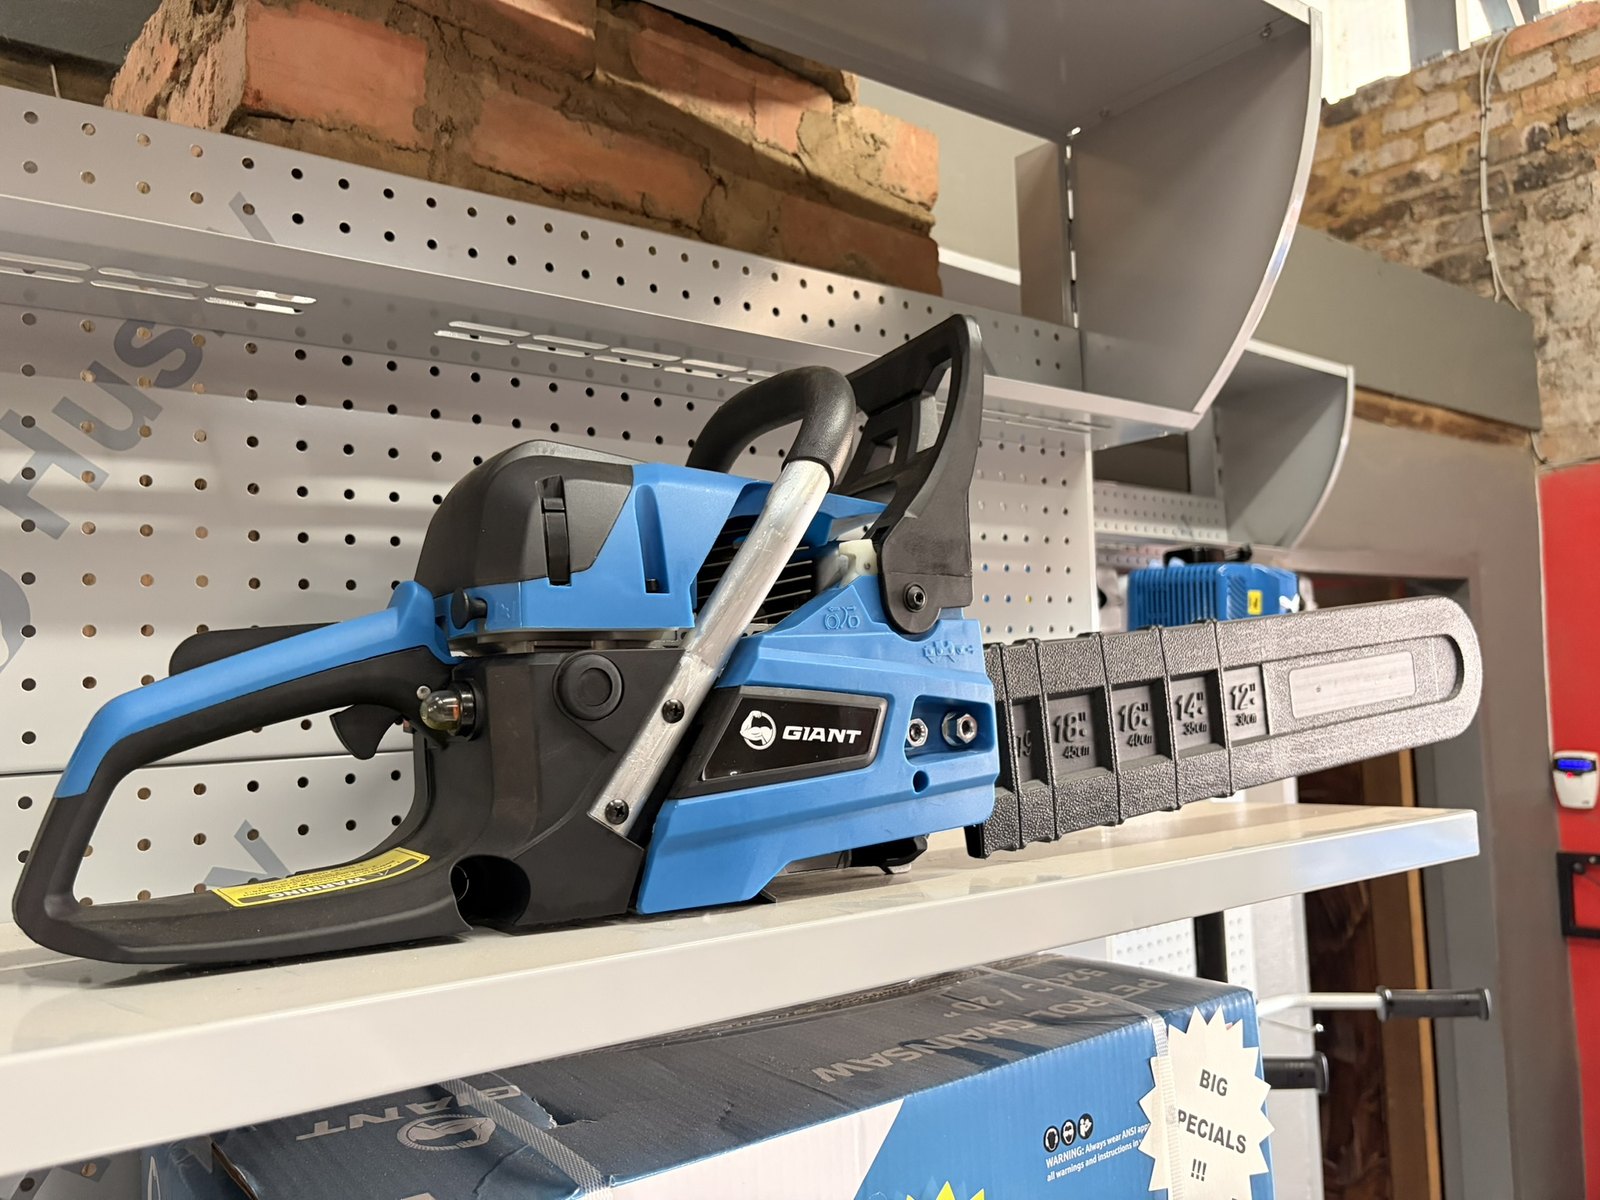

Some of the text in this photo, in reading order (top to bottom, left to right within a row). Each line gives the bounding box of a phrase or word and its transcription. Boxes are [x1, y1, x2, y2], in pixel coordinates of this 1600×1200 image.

[0, 312, 226, 540] Hus
[782, 725, 862, 744] GIANT
[267, 876, 367, 898] WARNING
[812, 978, 1168, 1083] PEROL CHAINSAW
[1199, 1069, 1228, 1096] BIG
[1045, 1146, 1084, 1168] WARNING:
[1085, 1139, 1106, 1155] Always
[1107, 1133, 1121, 1147] wear
[1122, 1127, 1137, 1140] ANSI
[1176, 1108, 1247, 1154] PECIALS
[1046, 1171, 1055, 1182] all
[1056, 1160, 1084, 1178] warnings
[1085, 1155, 1097, 1167] and
[1098, 1142, 1132, 1162] instructions
[1190, 1158, 1207, 1182] !!!
